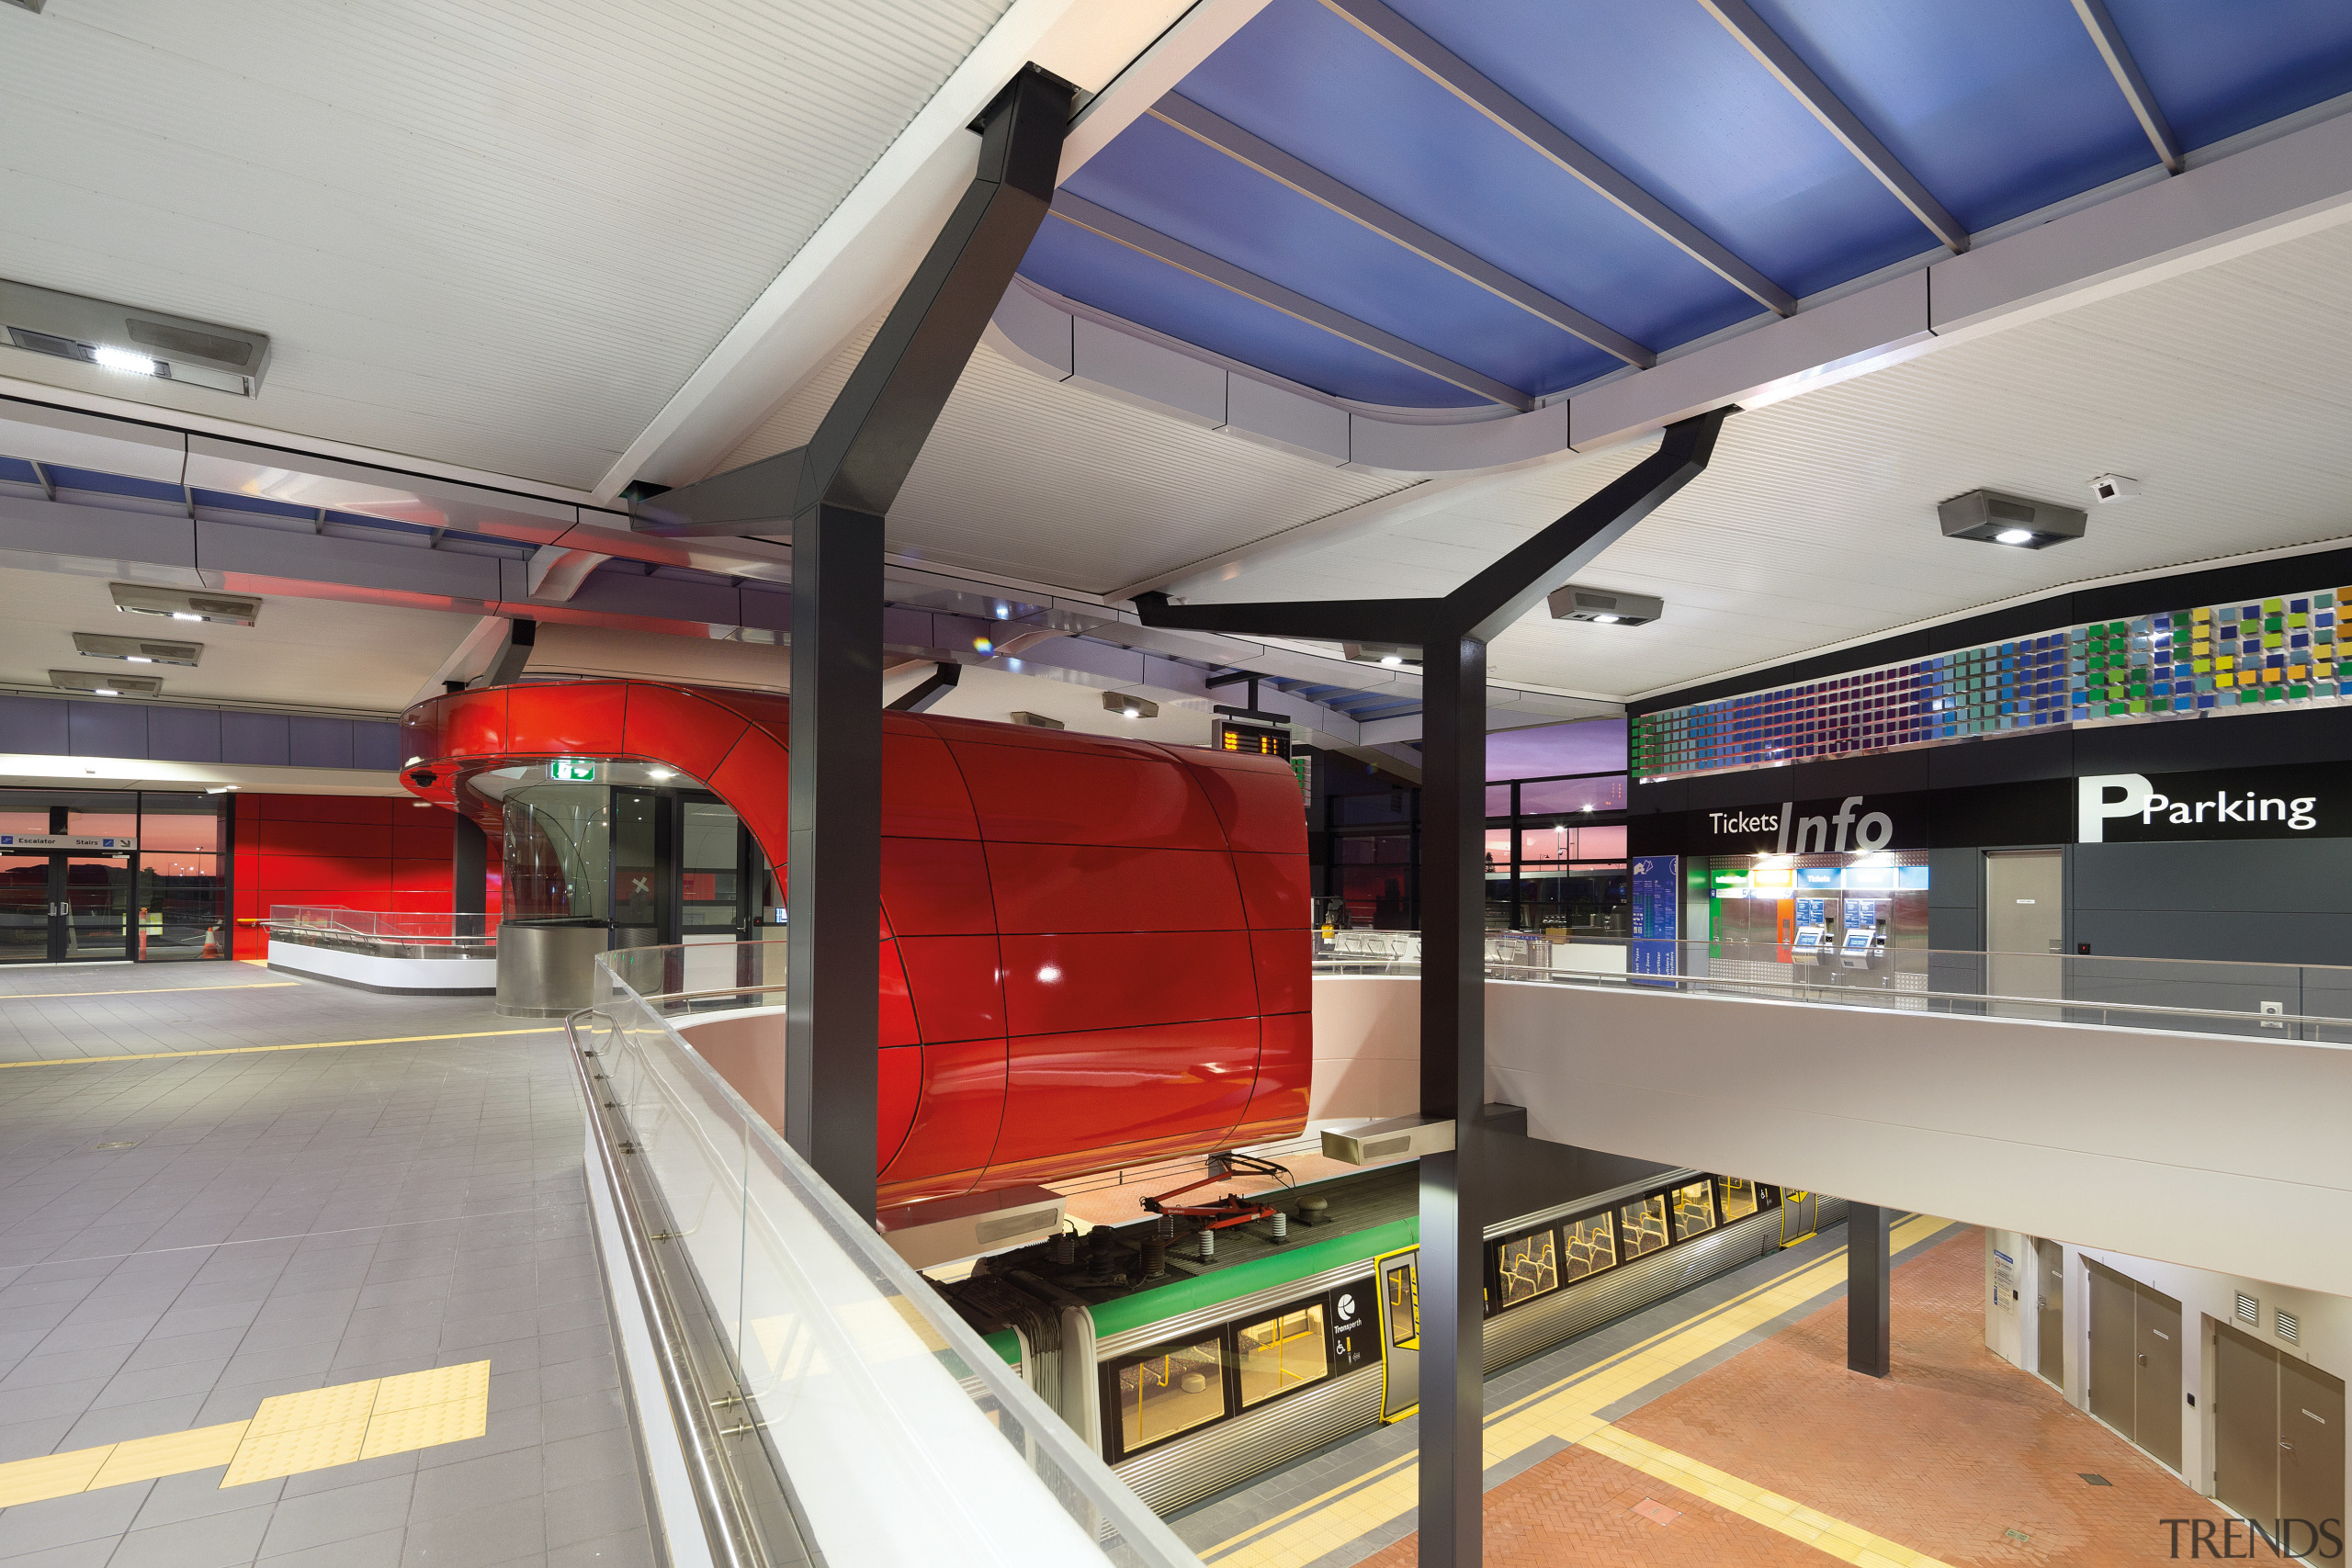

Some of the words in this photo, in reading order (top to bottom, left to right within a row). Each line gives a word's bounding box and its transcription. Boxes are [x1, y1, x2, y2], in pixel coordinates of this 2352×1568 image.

[1709, 811, 1779, 834] Tickets
[1777, 796, 1894, 853] Info
[2078, 773, 2154, 842] P
[2143, 791, 2317, 830] Parking
[1334, 1318, 1363, 1334] Transperth
